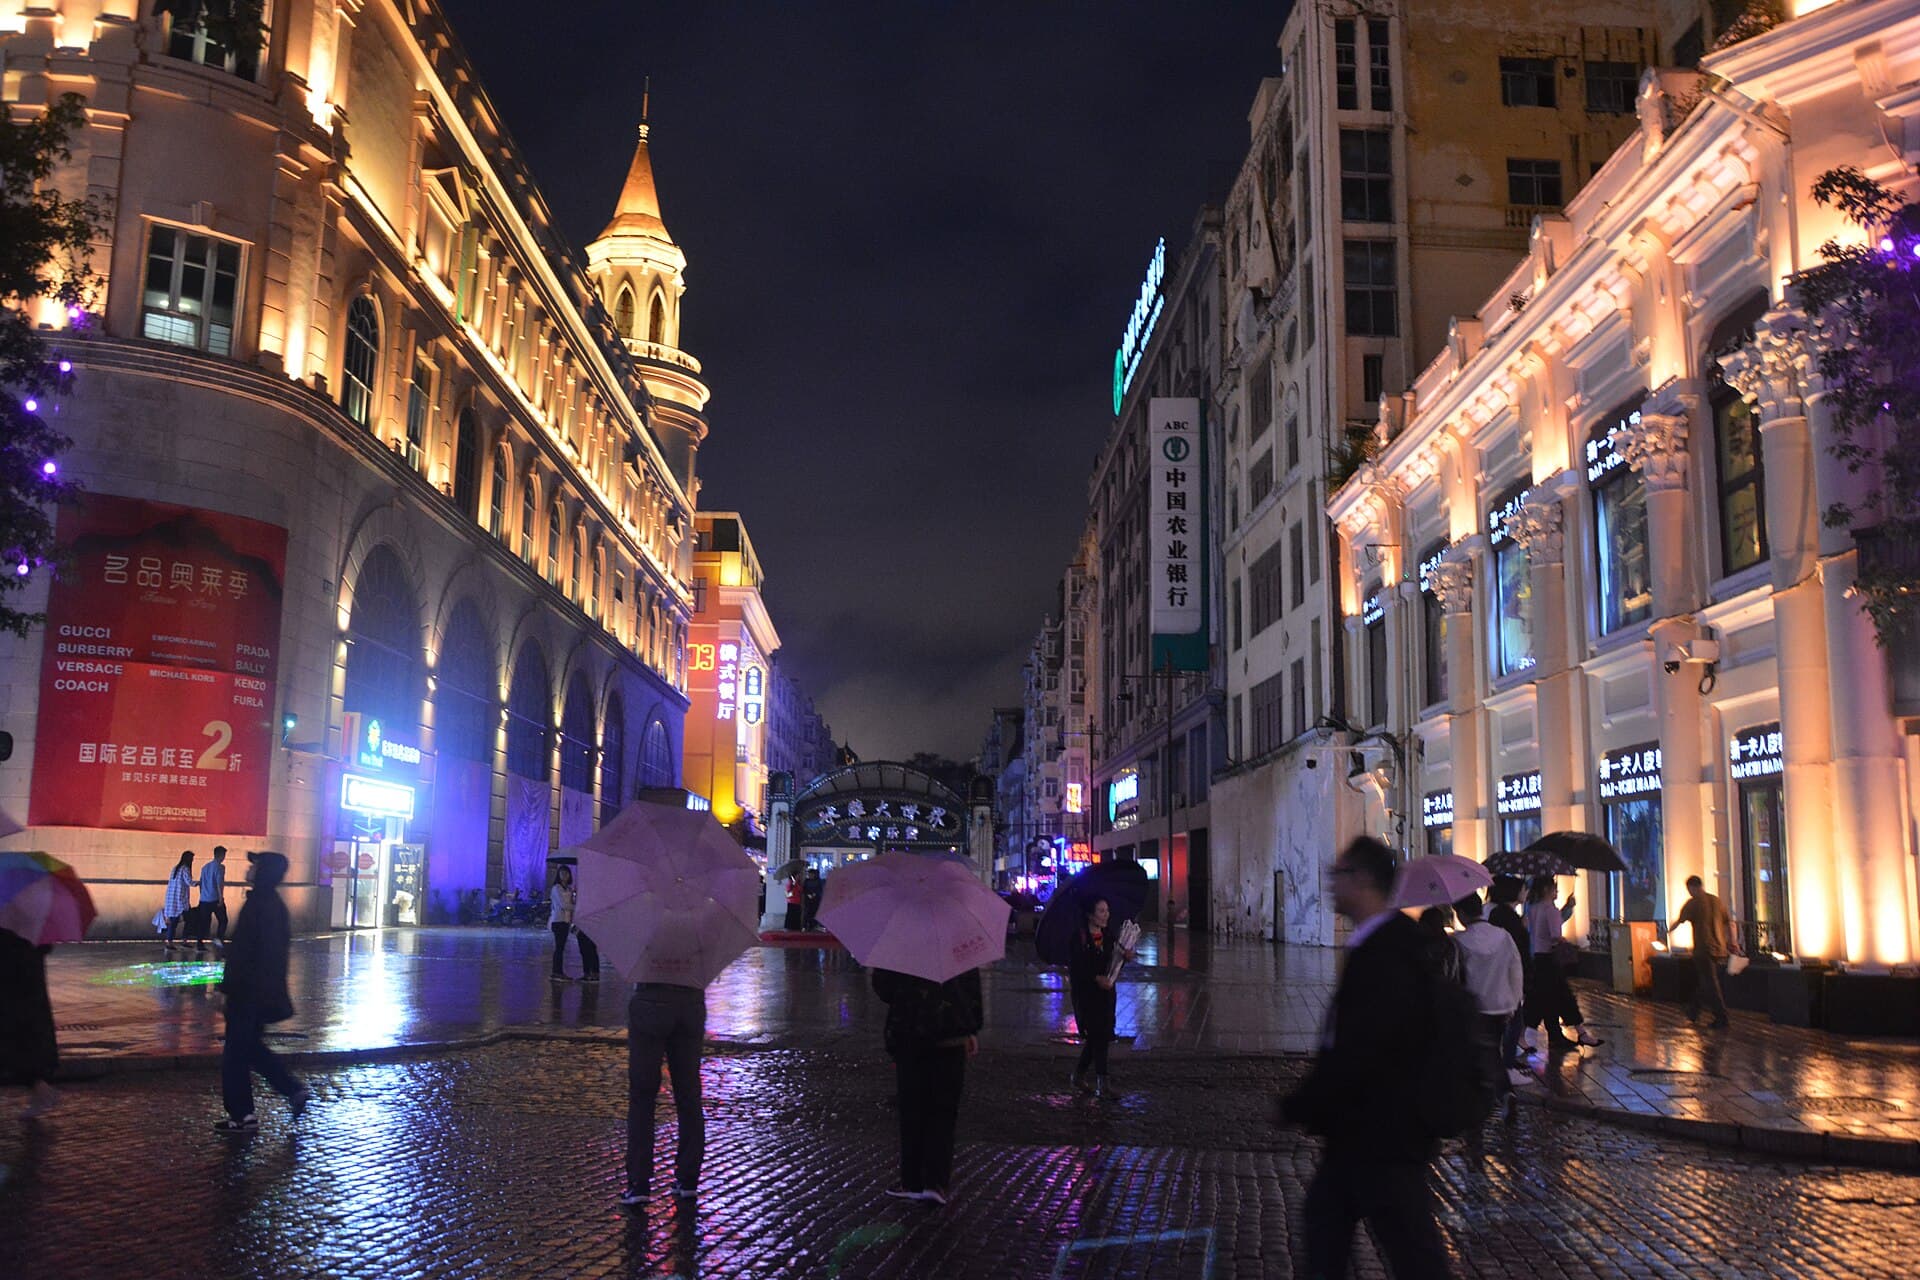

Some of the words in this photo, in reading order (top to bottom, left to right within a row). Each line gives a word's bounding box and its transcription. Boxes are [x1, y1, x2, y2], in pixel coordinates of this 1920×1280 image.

[1164, 421, 1189, 430] ABC
[1166, 467, 1188, 608] 中国农业银行
[104, 553, 248, 600] 名品奥莱季
[60, 625, 111, 639] GUCCI
[58, 643, 134, 657] BURBERRY
[236, 643, 271, 659] PRADA
[56, 661, 124, 675] VERSACE
[235, 660, 266, 674] BALLY
[149, 669, 189, 681] MICHAEL
[190, 672, 216, 683] KORS
[54, 679, 110, 692] COACH
[234, 677, 267, 691] KENZO
[233, 695, 264, 708] FURLA
[79, 720, 243, 773] 国际名品低至2折
[122, 771, 208, 787] 详见5F奥莱名品区
